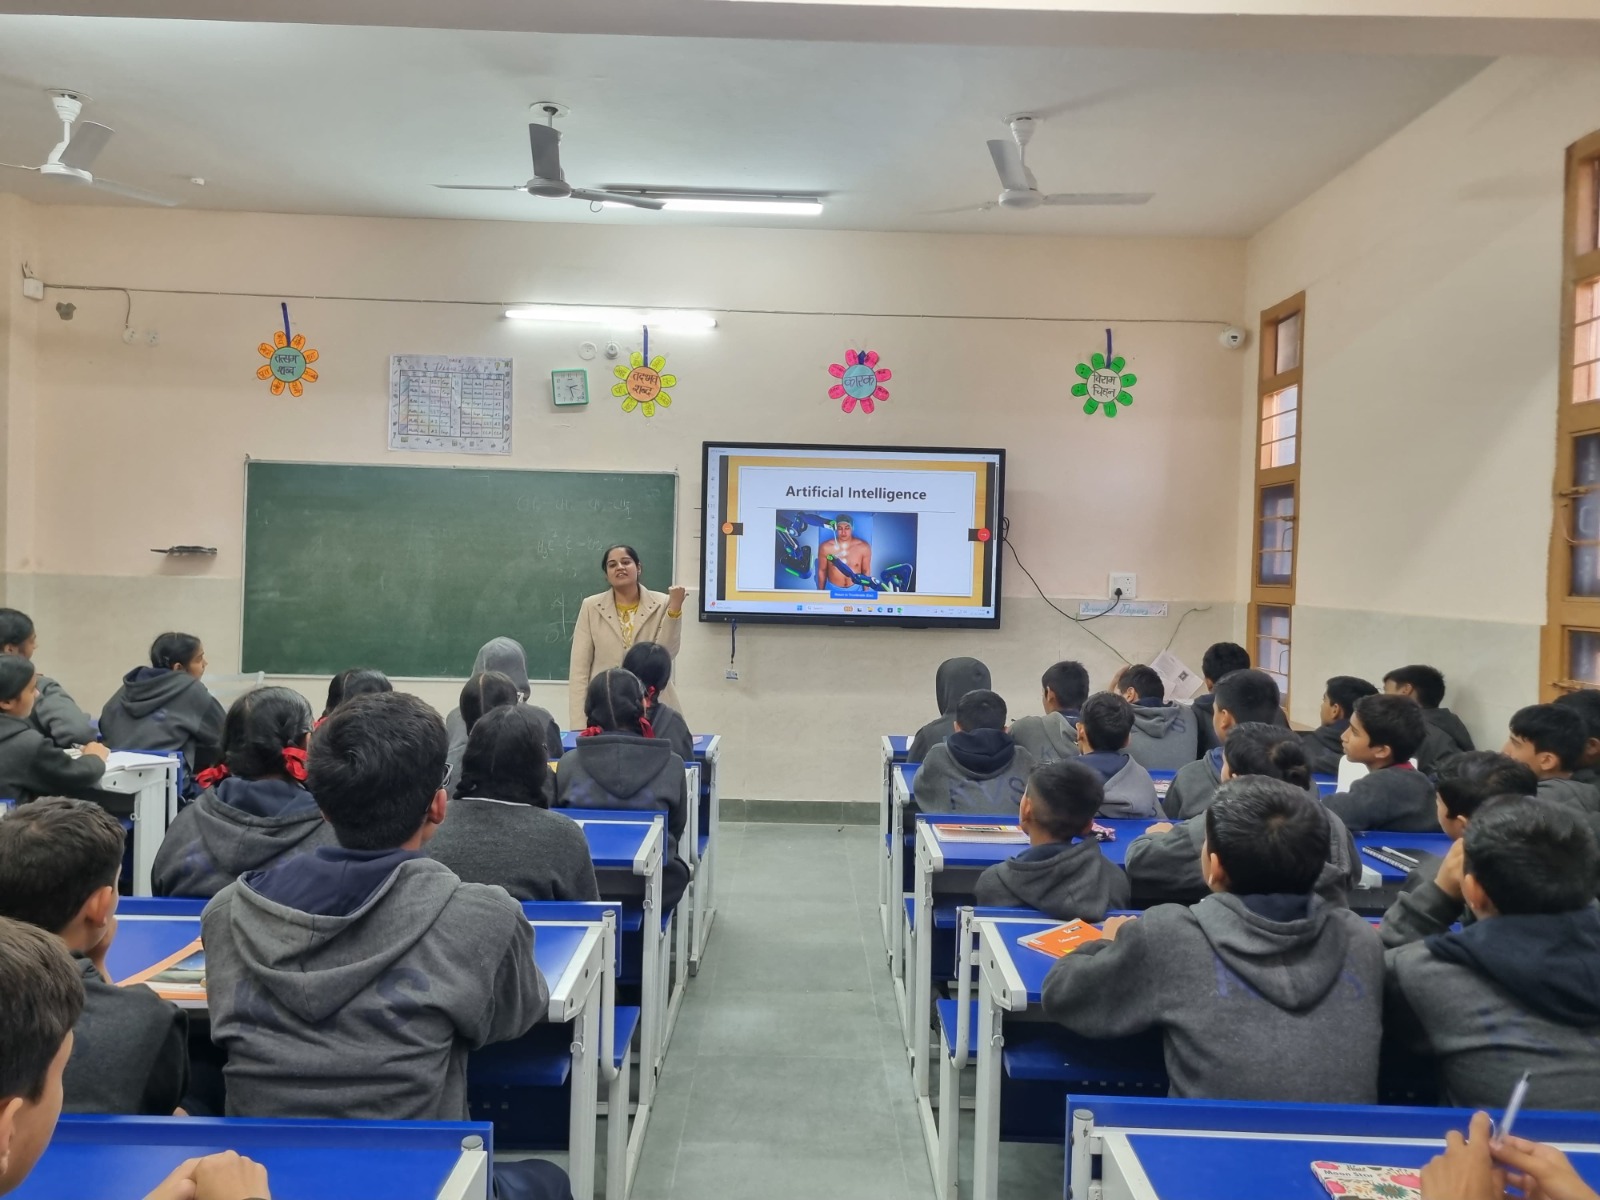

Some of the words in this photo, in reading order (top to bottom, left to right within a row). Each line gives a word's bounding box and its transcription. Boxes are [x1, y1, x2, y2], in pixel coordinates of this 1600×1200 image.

[844, 375, 875, 387] कारक
[785, 485, 844, 499] Artificial
[848, 486, 927, 503] Intelligence
